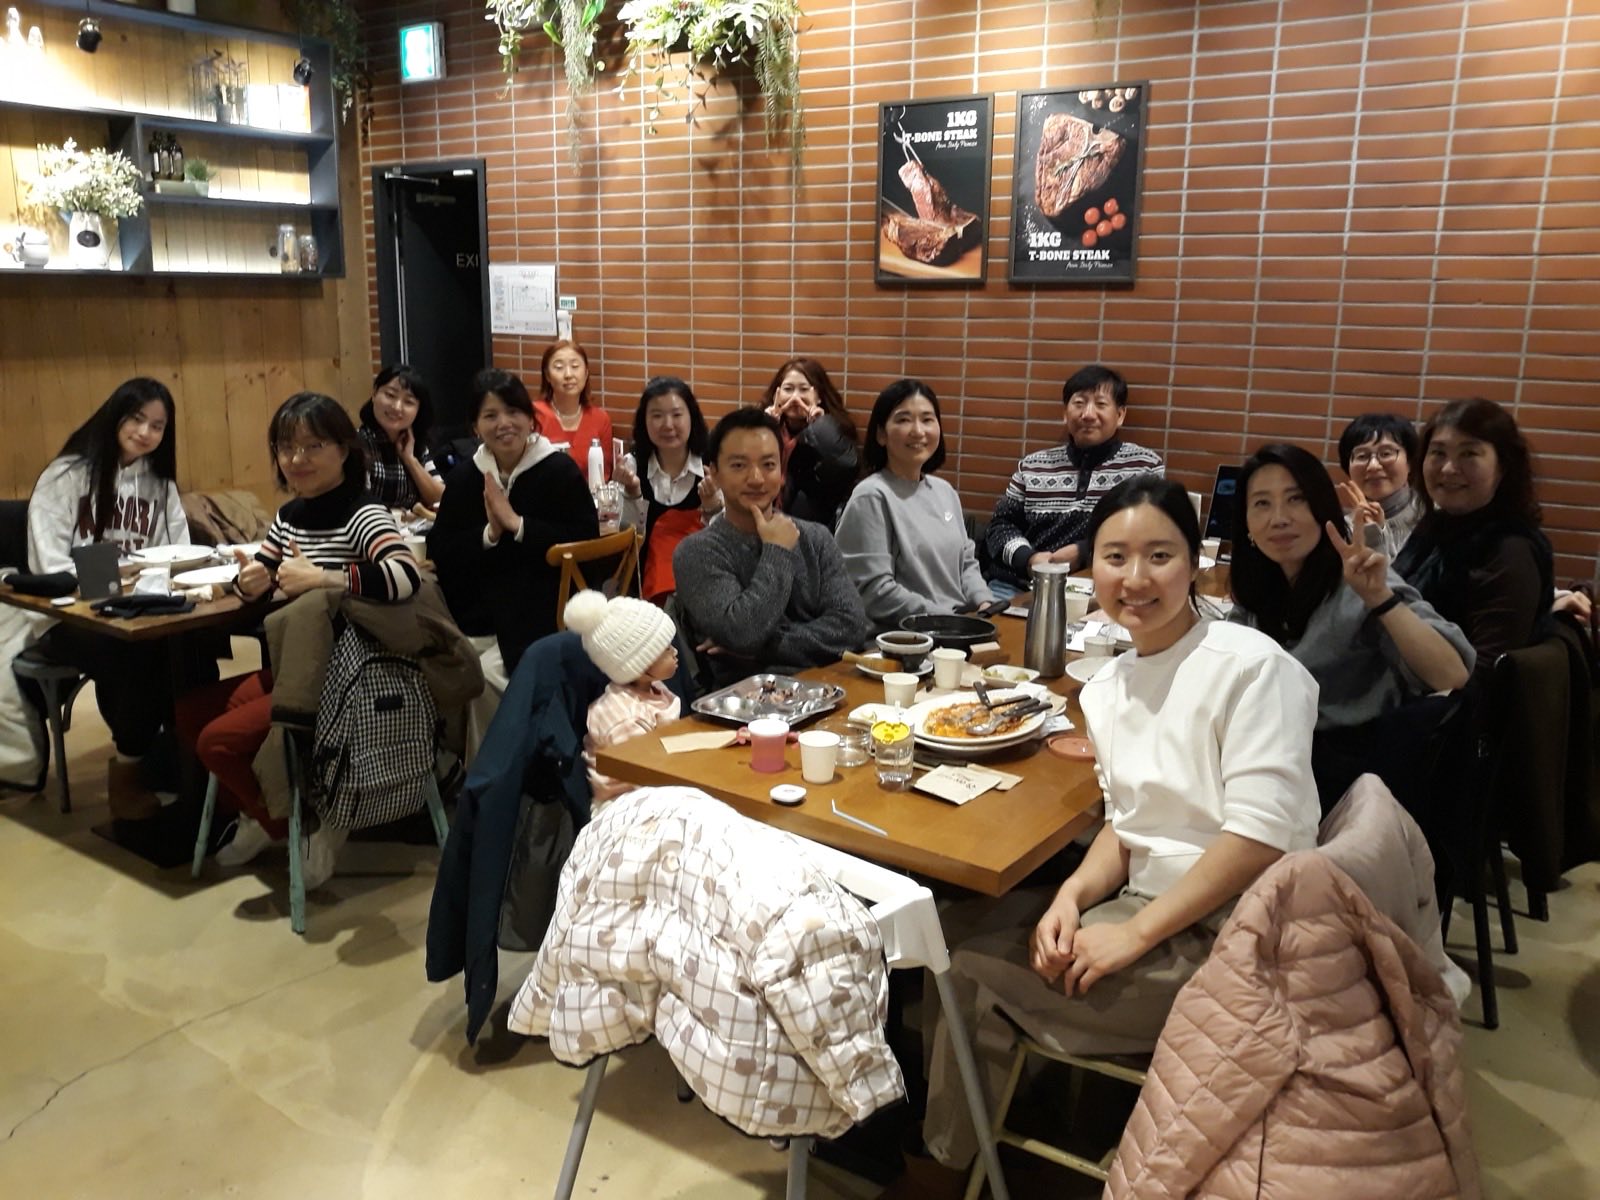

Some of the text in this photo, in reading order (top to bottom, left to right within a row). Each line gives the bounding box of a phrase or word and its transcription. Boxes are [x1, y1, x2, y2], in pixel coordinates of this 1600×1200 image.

[904, 128, 978, 143] T-BONE STEAK
[1029, 232, 1061, 247] 1KG
[456, 252, 480, 269] EXI
[1029, 250, 1110, 260] T-BONE STEAK
